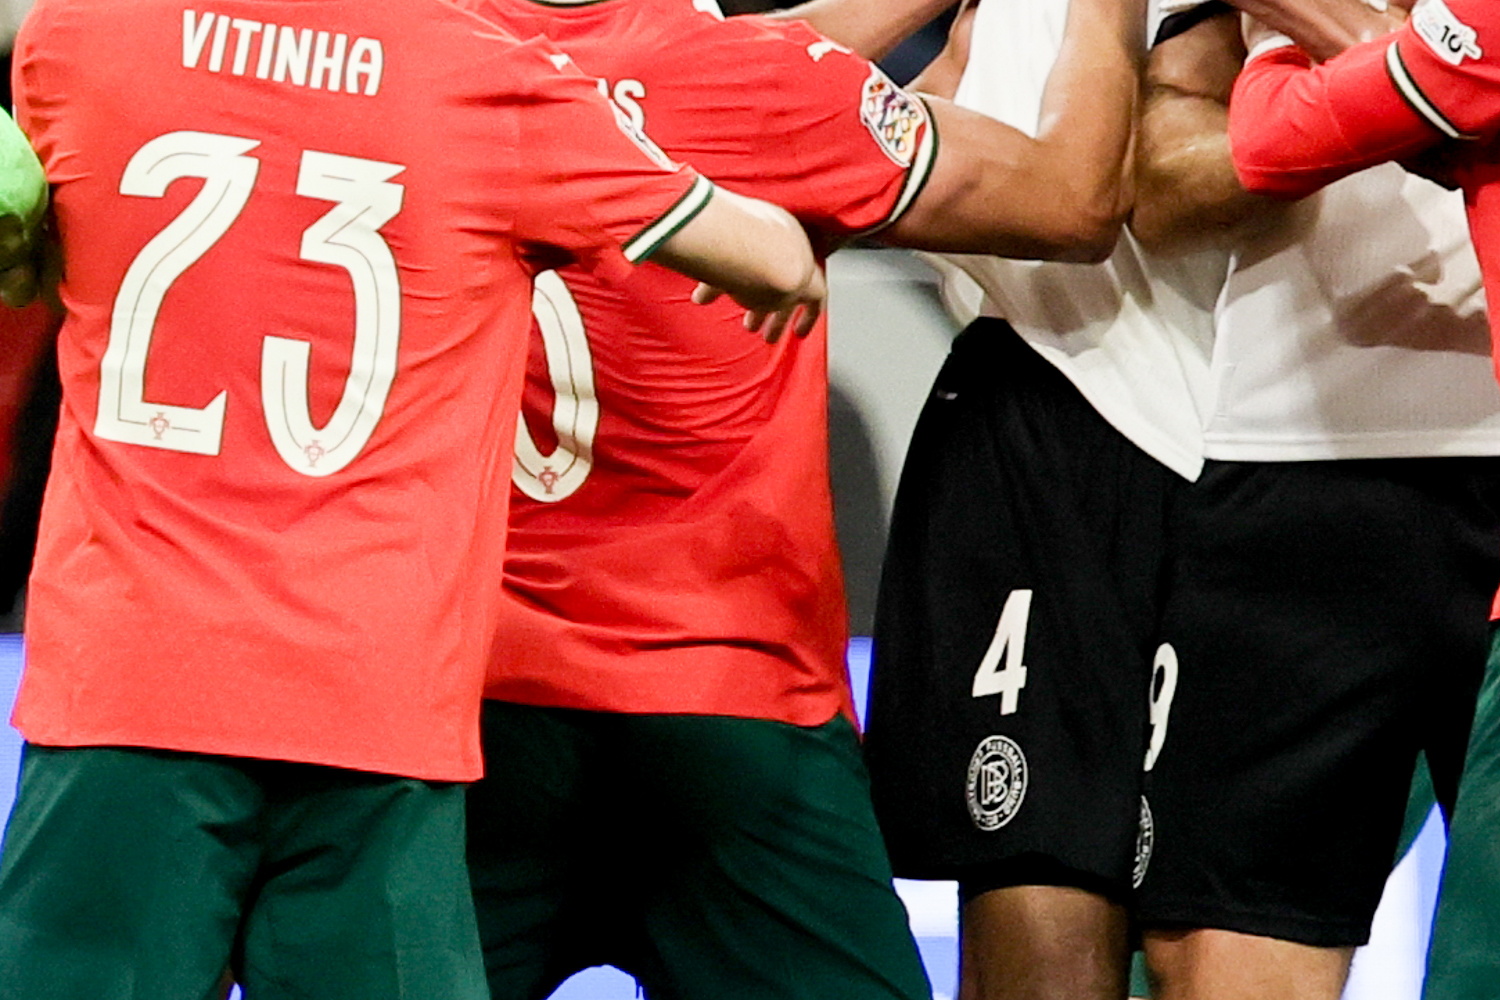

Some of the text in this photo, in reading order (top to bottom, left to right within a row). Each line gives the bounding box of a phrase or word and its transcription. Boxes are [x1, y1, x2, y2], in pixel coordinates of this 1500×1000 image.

[182, 9, 384, 97] VITINHA
[94, 130, 407, 477] 23
[972, 589, 1033, 716] 4
[1144, 642, 1178, 771] 9
